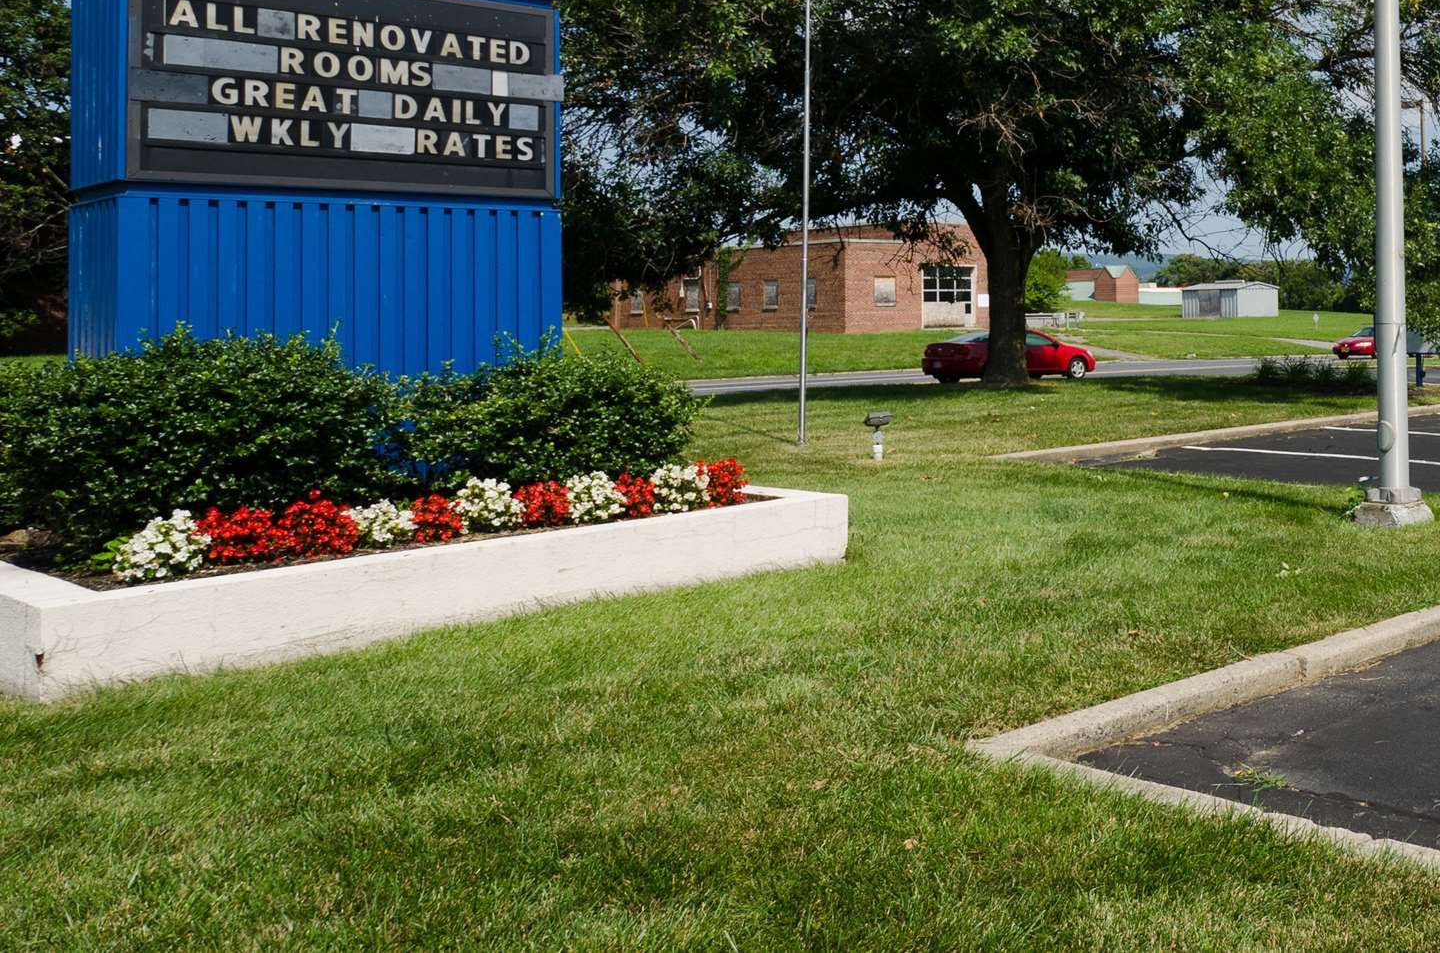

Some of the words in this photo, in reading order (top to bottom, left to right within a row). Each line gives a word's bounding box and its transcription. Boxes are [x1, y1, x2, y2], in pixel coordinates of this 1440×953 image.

[168, 0, 255, 35] ALL
[297, 13, 531, 66] RENOVATED
[280, 47, 432, 87] ROOMS
[211, 77, 358, 115] GREAT
[394, 94, 507, 127] DAILY
[230, 115, 350, 149] WKLY
[416, 129, 534, 161] RATES
